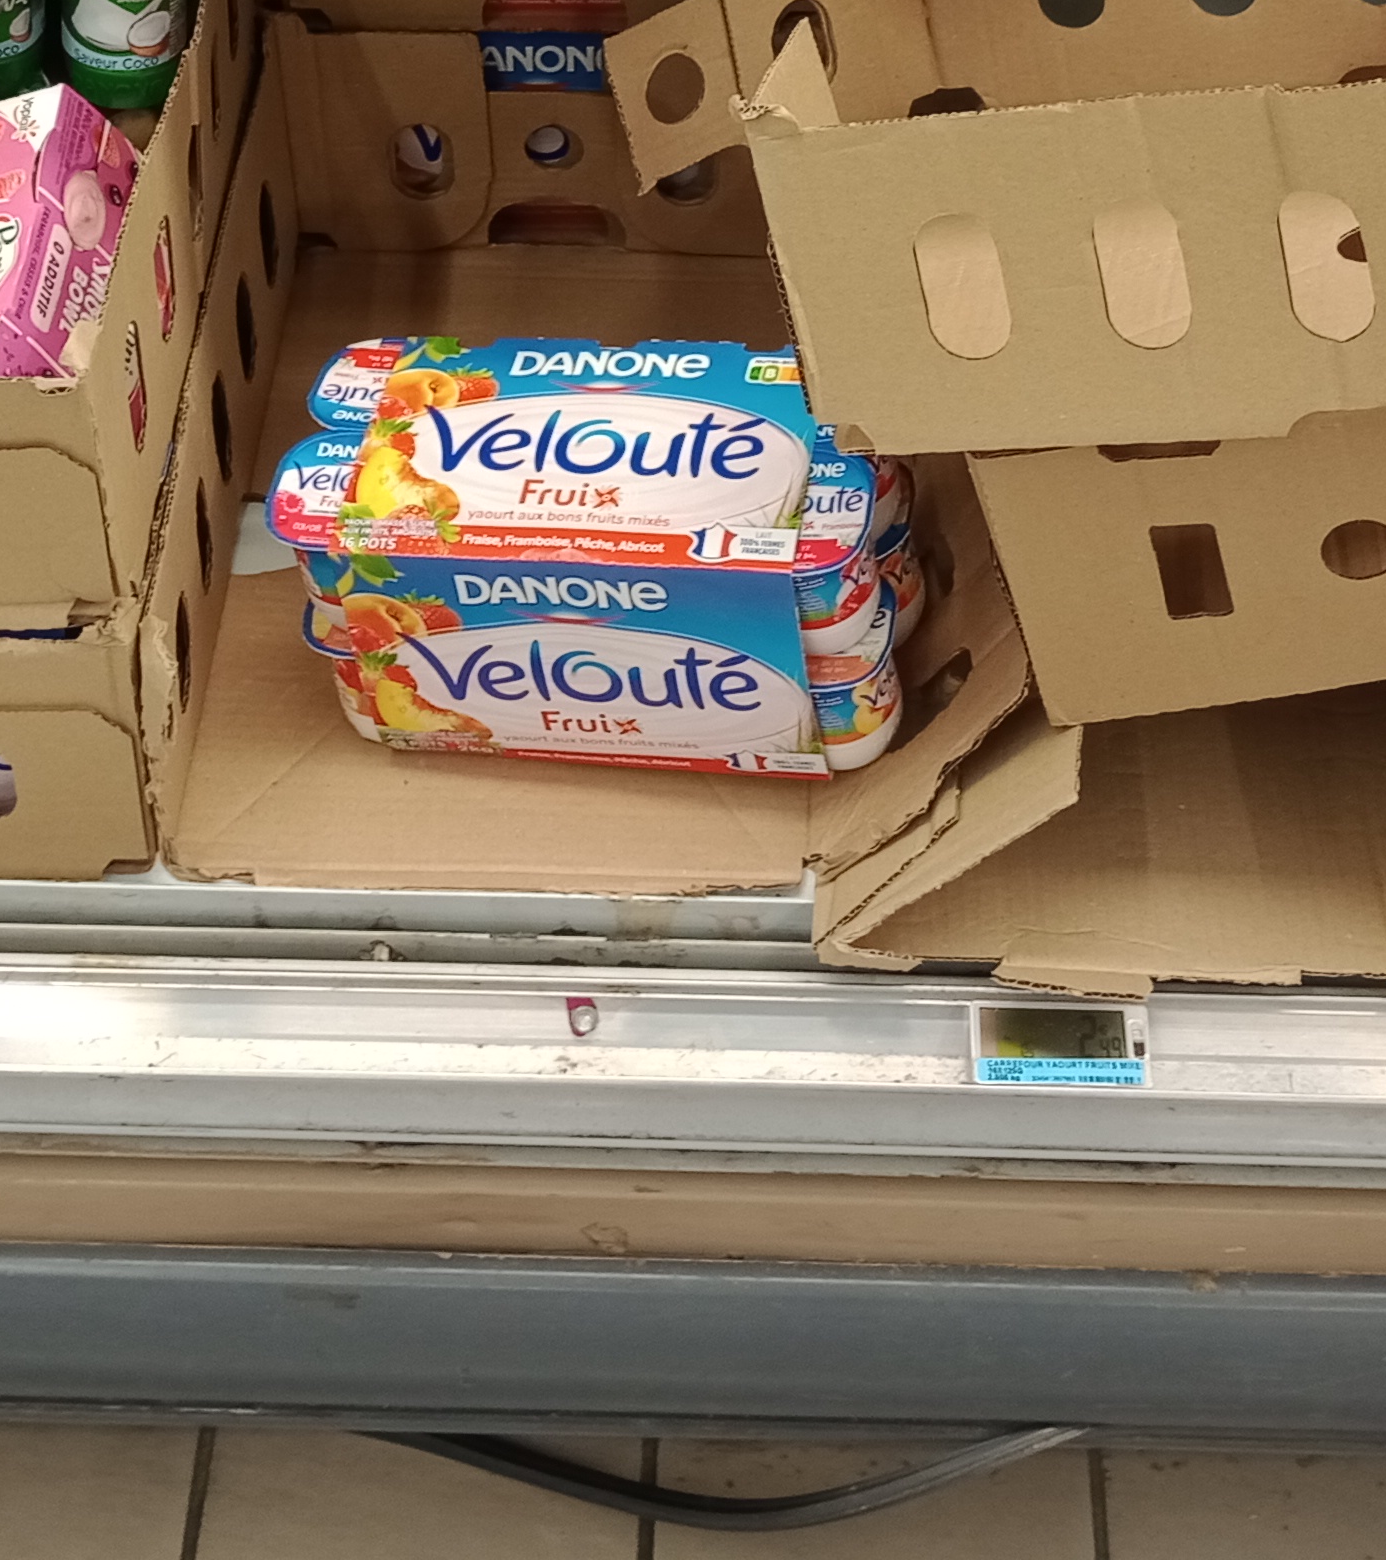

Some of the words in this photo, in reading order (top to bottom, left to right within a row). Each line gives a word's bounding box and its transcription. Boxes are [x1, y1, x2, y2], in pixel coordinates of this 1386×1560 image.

[123, 56, 159, 69] Coco
[36, 255, 61, 319] ADDITIF
[519, 480, 621, 508] Fruix
[468, 510, 515, 524] yaourt
[518, 512, 543, 522] aux
[547, 512, 582, 523] bons
[585, 512, 623, 525] fruits
[628, 513, 670, 527] mixés
[340, 537, 355, 548] 16
[359, 537, 397, 550] POTS
[461, 534, 502, 548] Fraise,
[504, 536, 572, 549] Framboise,
[575, 537, 616, 551] Pêche,
[619, 540, 664, 553] Abricot
[542, 711, 642, 735] Fruix
